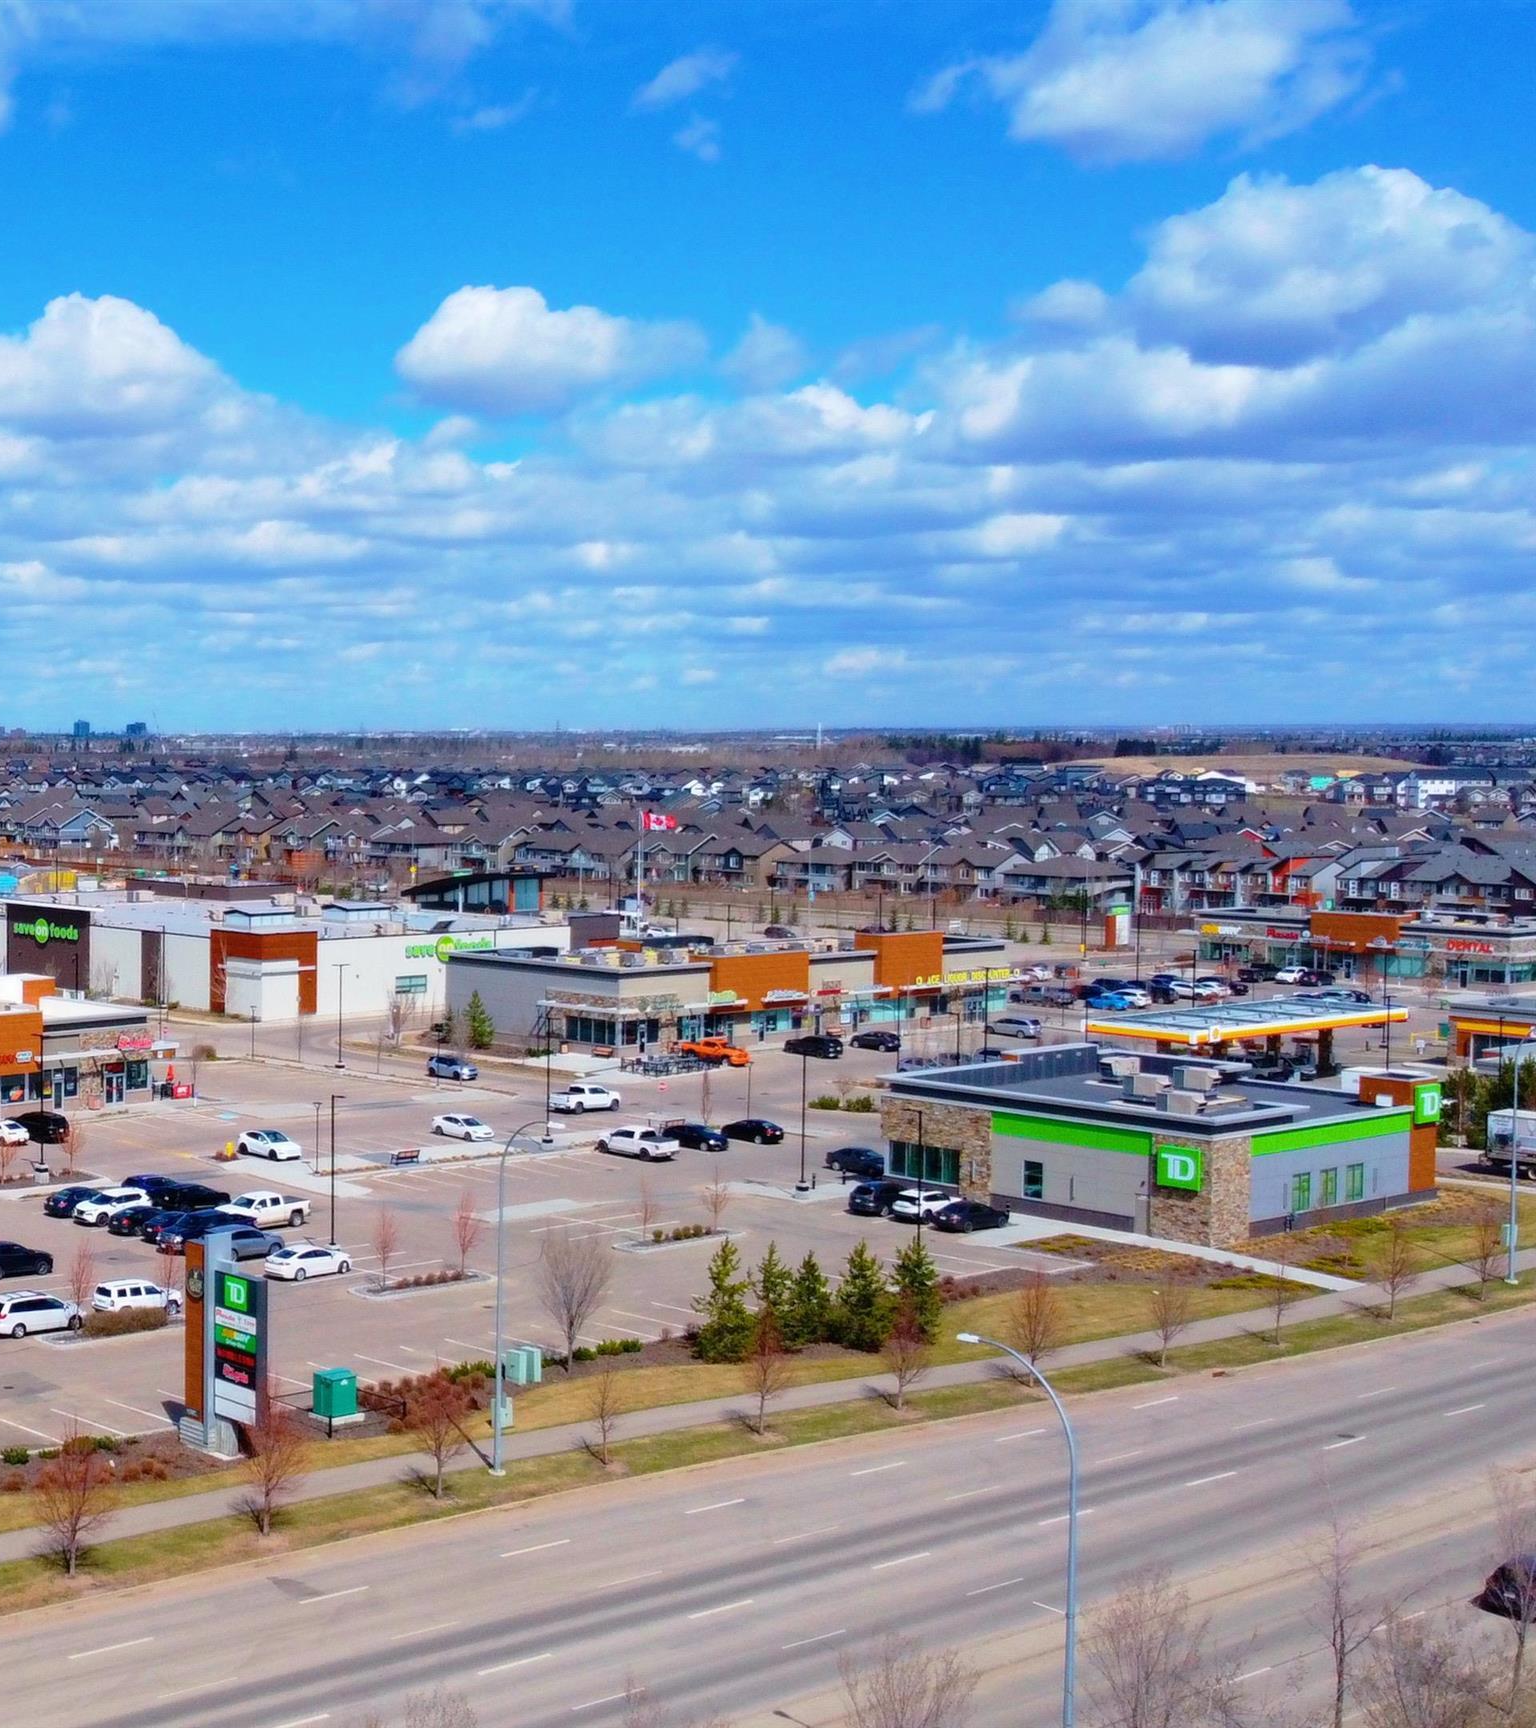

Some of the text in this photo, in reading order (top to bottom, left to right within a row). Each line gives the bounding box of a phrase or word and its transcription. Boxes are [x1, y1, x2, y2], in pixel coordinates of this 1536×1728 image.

[50, 922, 79, 940] foods
[1447, 938, 1494, 953] DENTAL
[1421, 1092, 1439, 1116] TD
[1161, 1153, 1195, 1181] TD
[226, 1282, 244, 1304] TD
